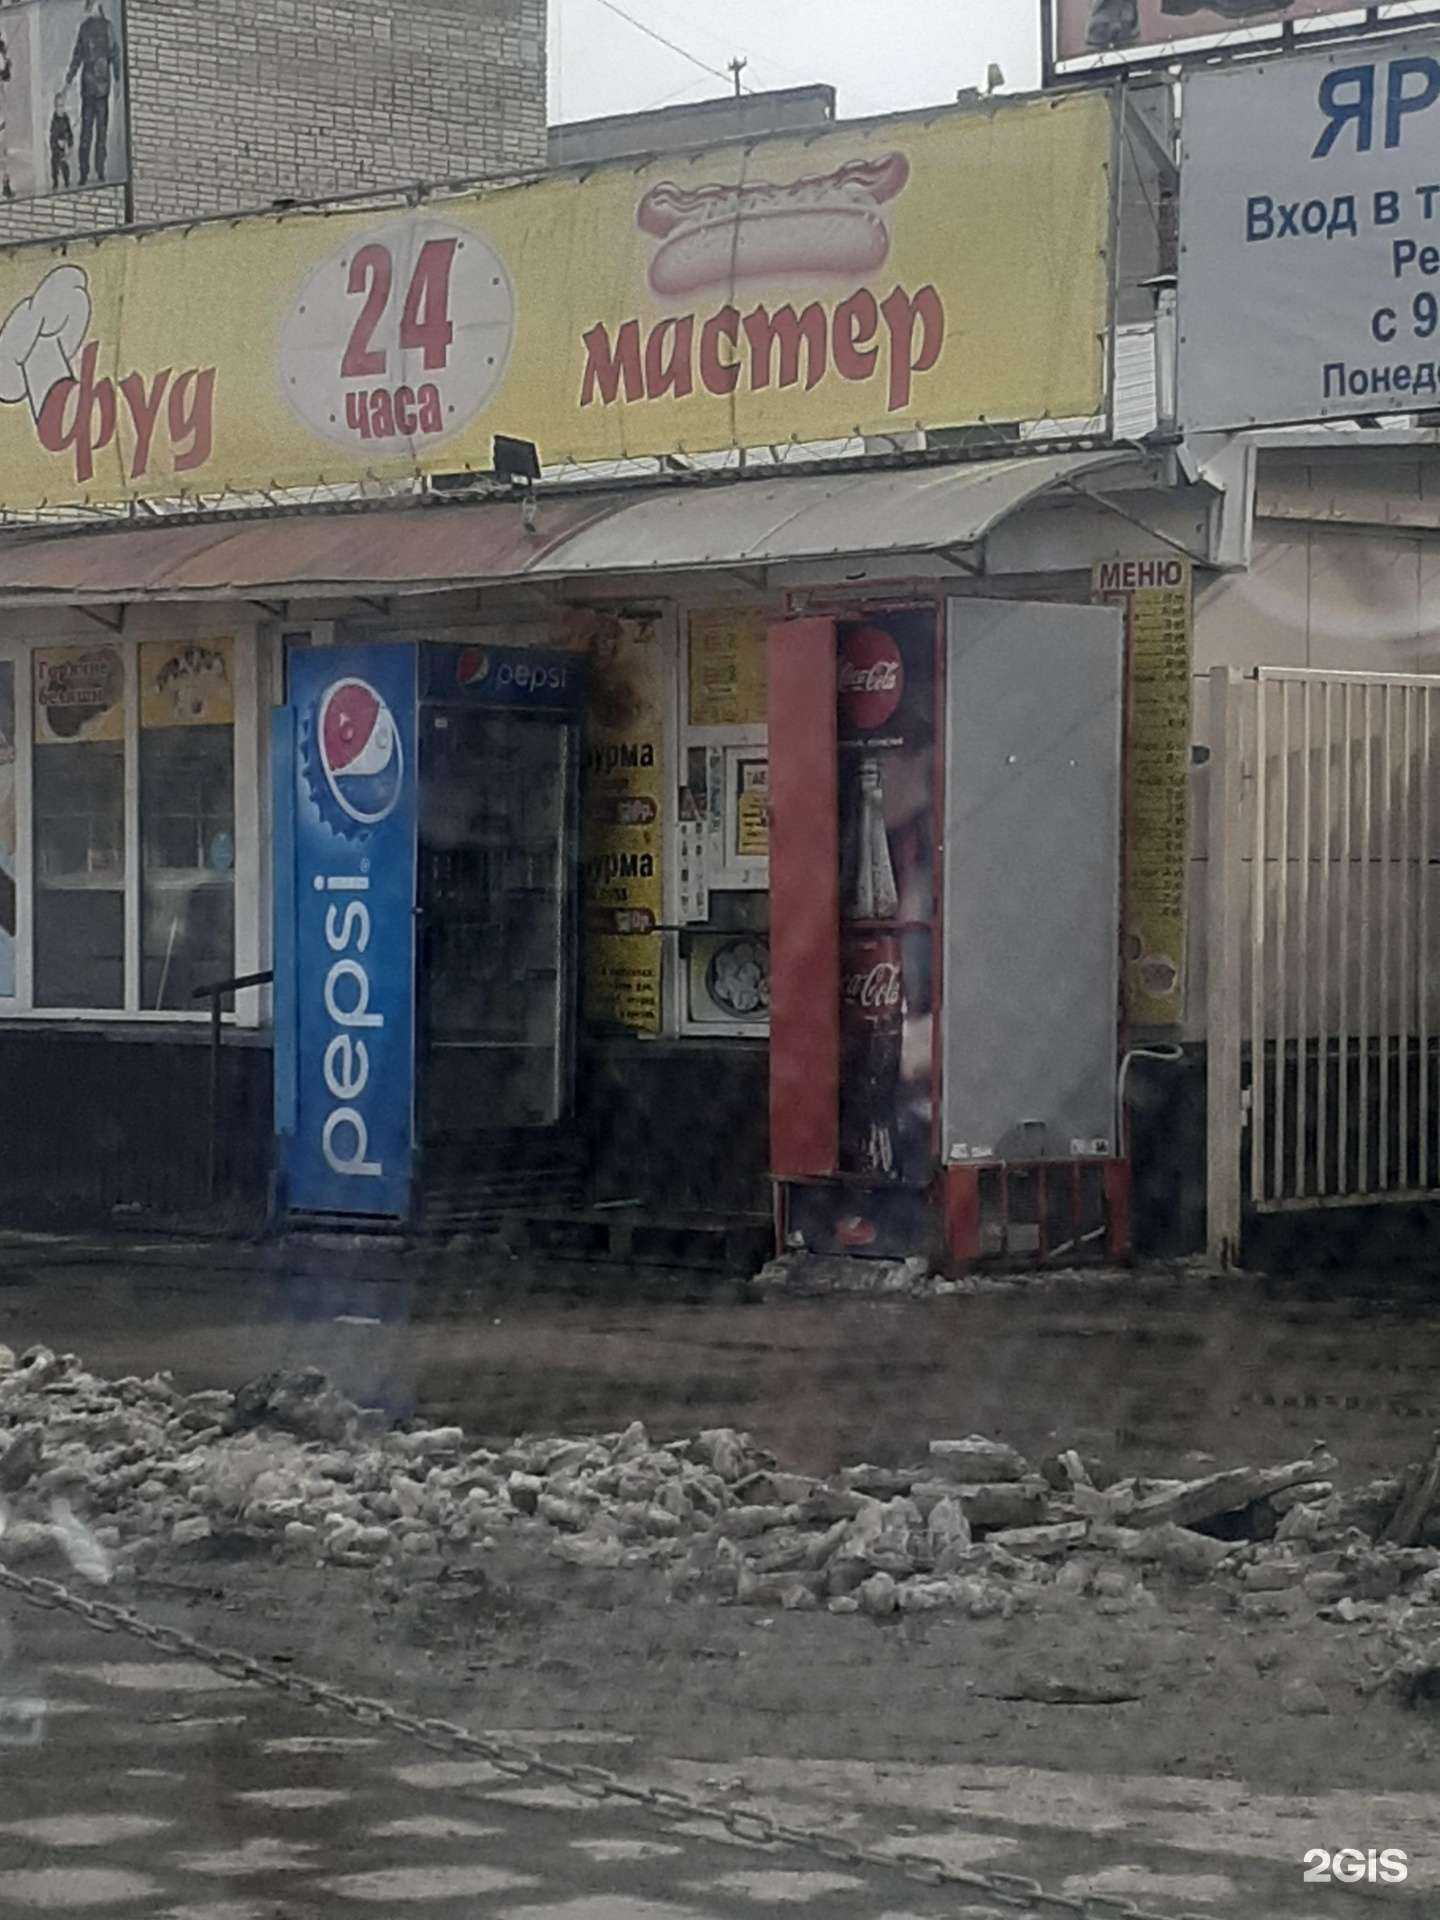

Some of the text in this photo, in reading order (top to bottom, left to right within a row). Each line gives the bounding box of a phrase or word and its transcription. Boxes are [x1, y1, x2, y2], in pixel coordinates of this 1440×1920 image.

[1246, 195, 1357, 242] Вход
[1374, 190, 1399, 225] в
[1393, 239, 1440, 278] Ре
[341, 237, 457, 378] 24
[1372, 291, 1438, 342] с 9
[580, 284, 944, 412] мастер
[1323, 362, 1440, 398] Понед
[37, 340, 217, 483] фуд
[345, 382, 443, 441] часа
[1100, 560, 1182, 589] МЕНЮ
[498, 663, 567, 692] pepsi
[313, 874, 384, 1176] pepsi
